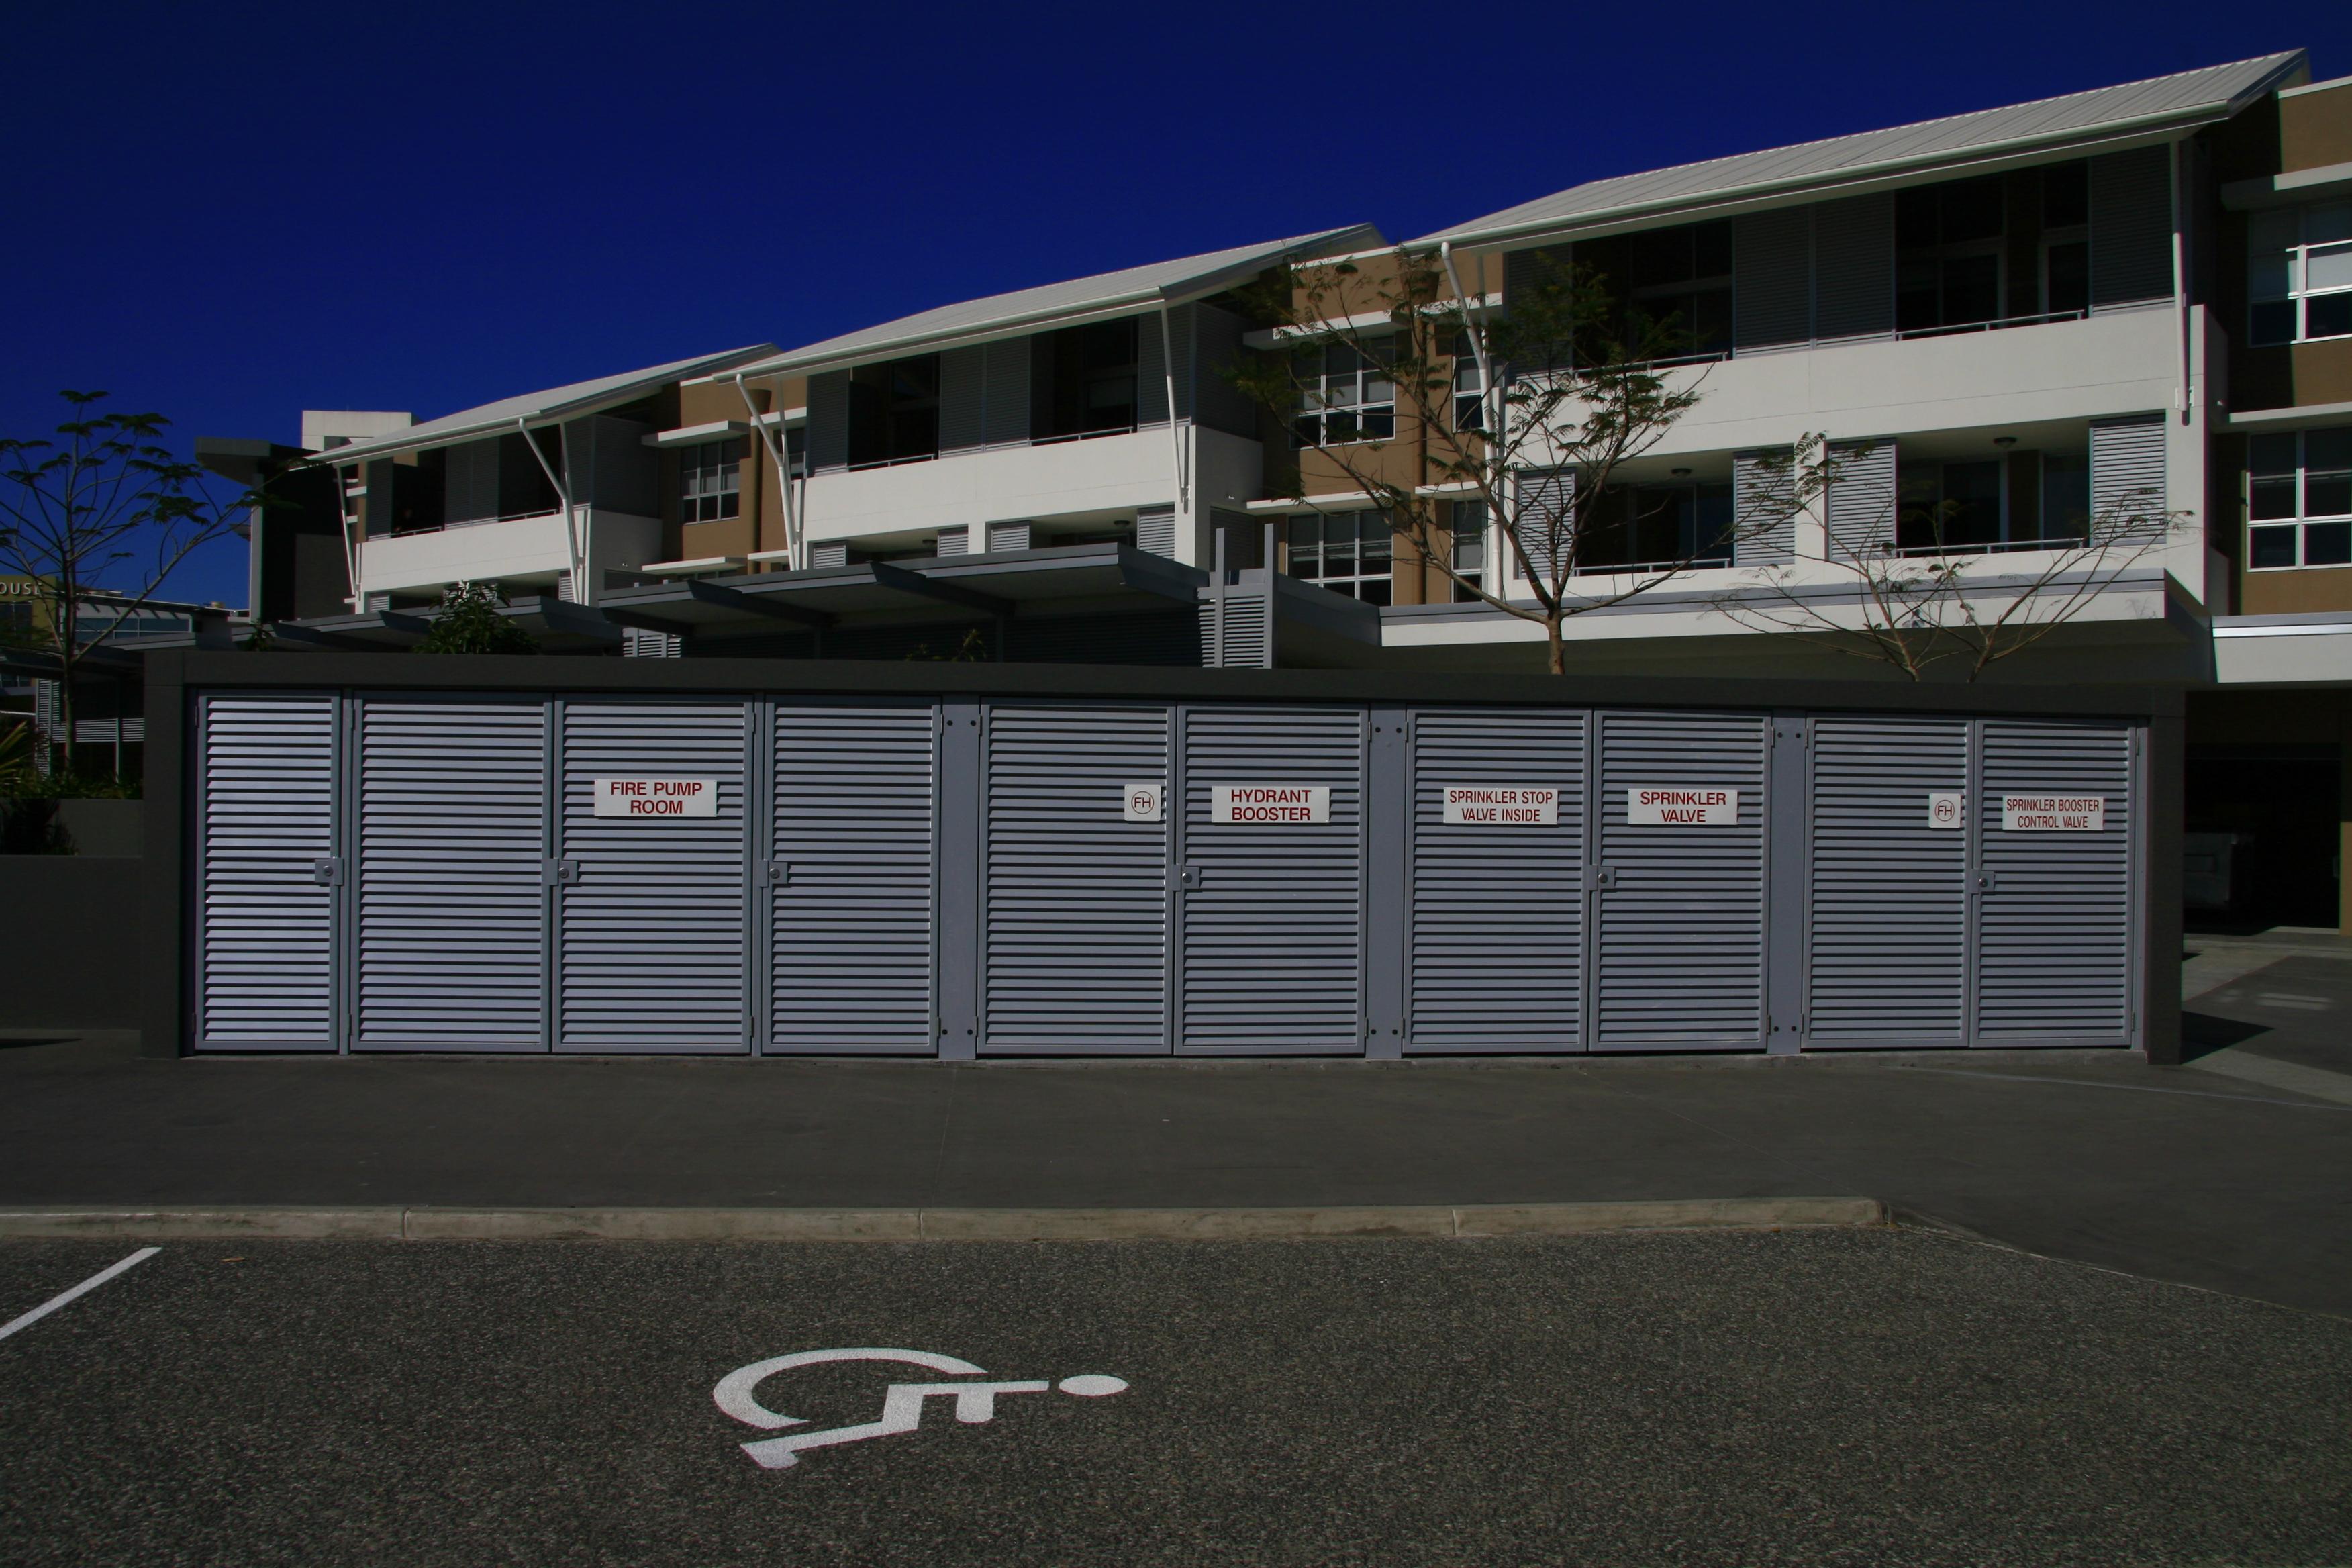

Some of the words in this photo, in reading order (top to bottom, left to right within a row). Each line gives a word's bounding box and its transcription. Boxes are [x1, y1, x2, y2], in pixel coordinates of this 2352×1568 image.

[611, 783, 646, 795] FIRE
[654, 783, 701, 795] PUMP
[1231, 789, 1311, 803] HYDRANT
[1450, 791, 1516, 803] SPRINKLER
[1522, 791, 1552, 804] STOP
[1640, 792, 1726, 805] SPRINKLER
[631, 801, 682, 814] ROOM
[1134, 798, 1150, 807] FH
[2007, 799, 2055, 811] SPRINKLER
[2059, 799, 2099, 811] BOOSTER
[1232, 807, 1310, 820] BOOSTER
[1462, 808, 1496, 821] VALVE
[1502, 809, 1540, 822] INSIDE
[1661, 810, 1706, 822] VALVE
[1938, 806, 1952, 815] FH
[2018, 816, 2059, 827] CONTROL
[2063, 816, 2088, 827] VALVE
